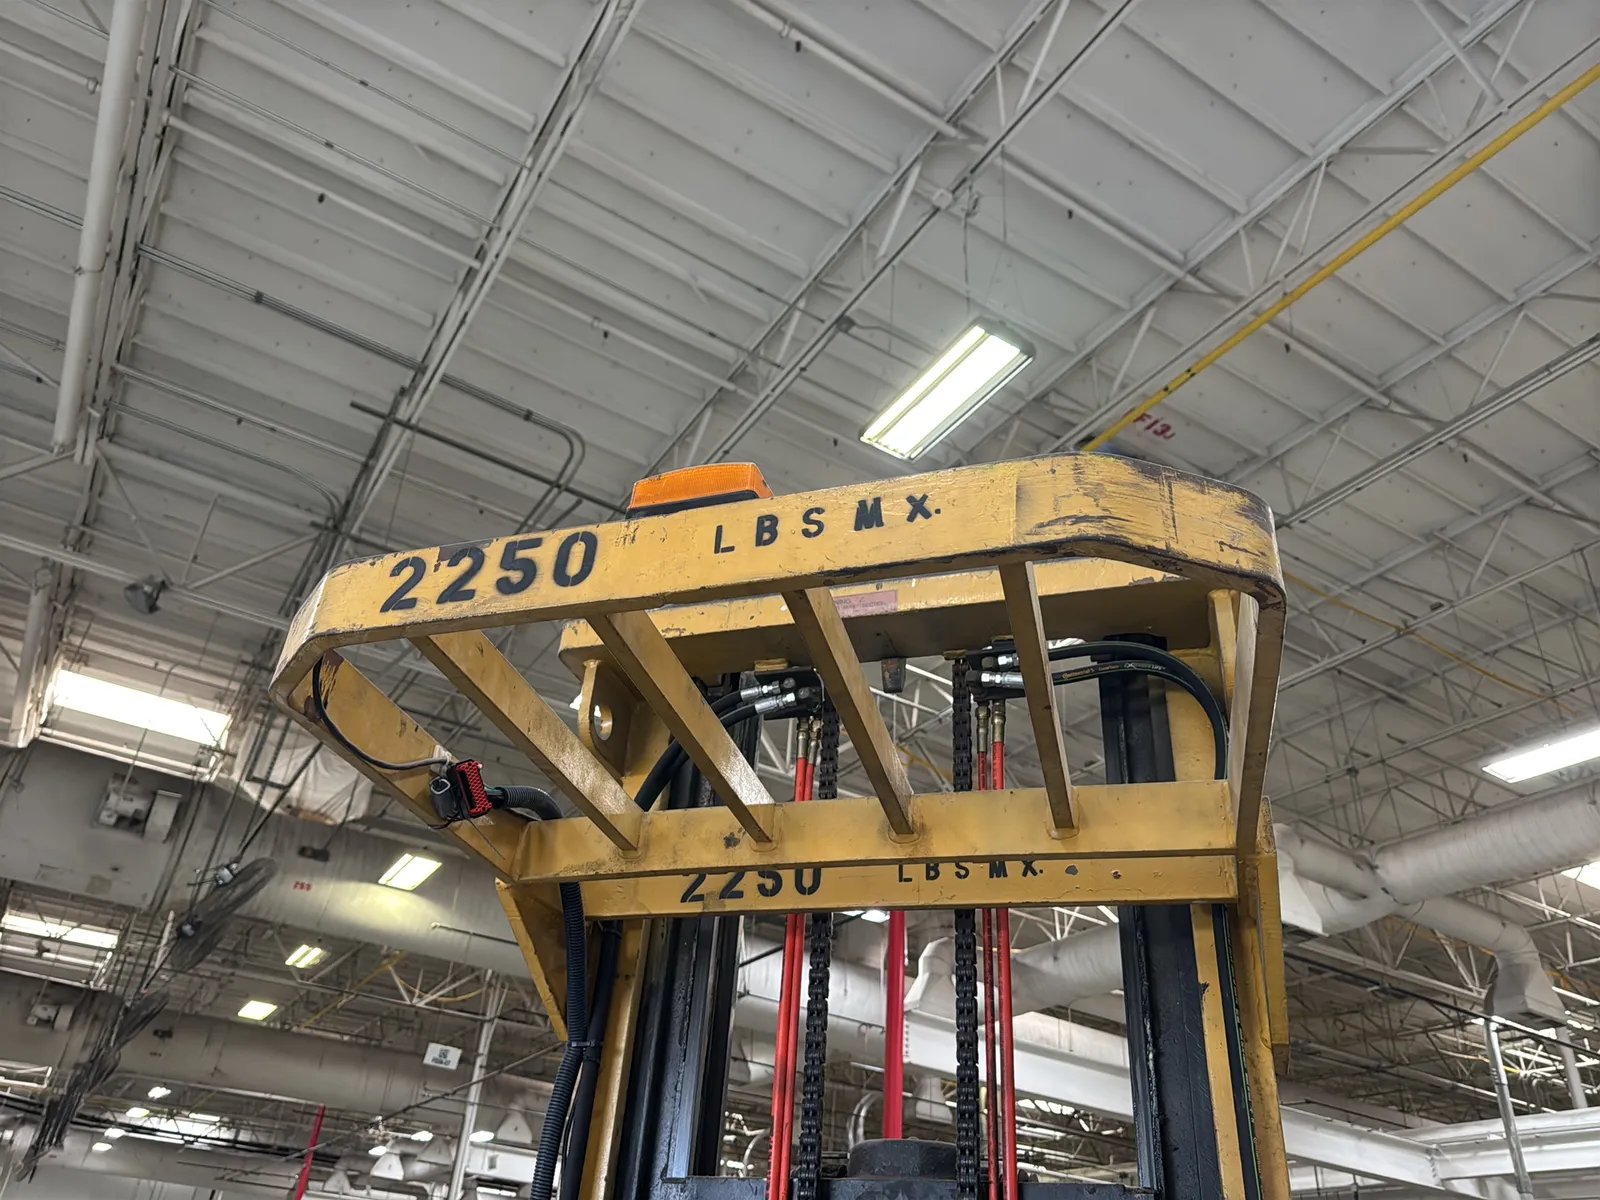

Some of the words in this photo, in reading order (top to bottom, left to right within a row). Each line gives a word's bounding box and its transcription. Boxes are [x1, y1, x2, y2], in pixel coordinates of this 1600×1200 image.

[380, 531, 598, 613] 2250
[714, 507, 825, 554] LBS
[680, 867, 822, 904] 2250
